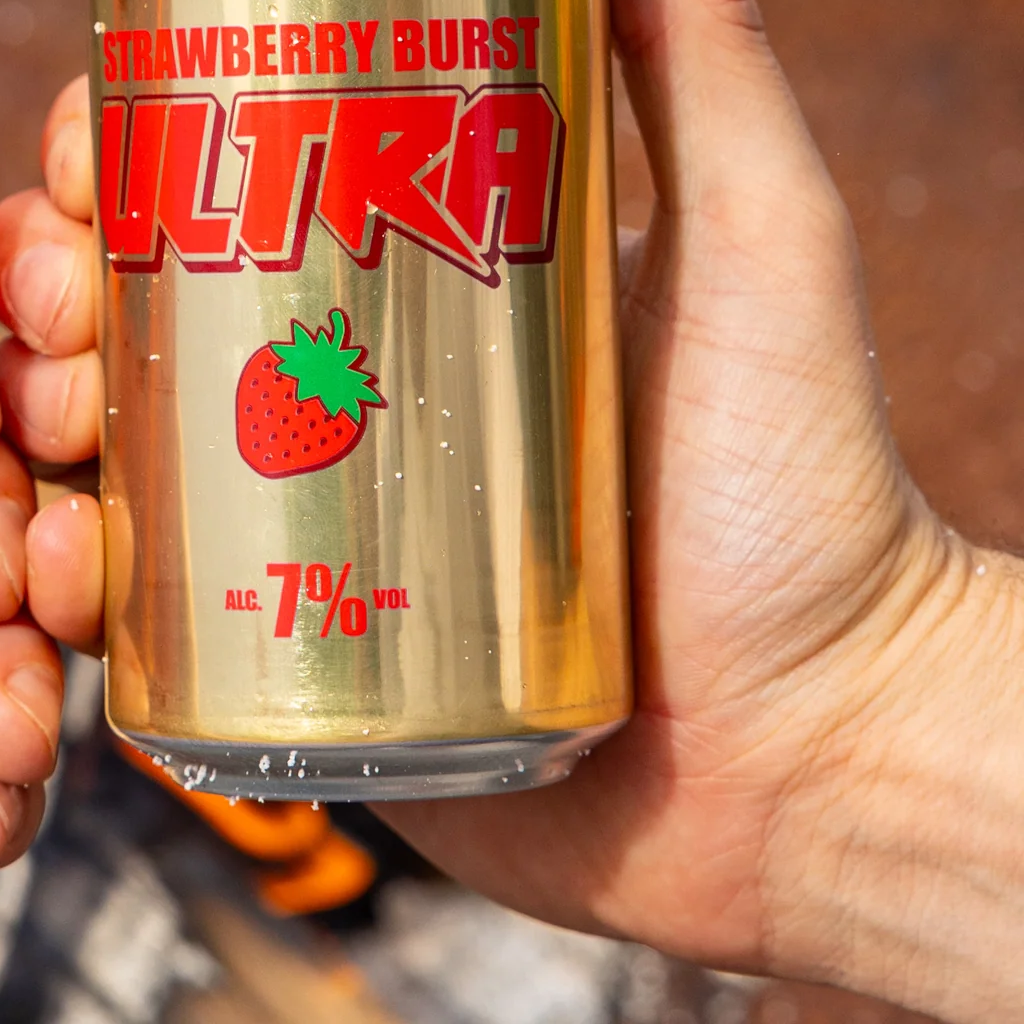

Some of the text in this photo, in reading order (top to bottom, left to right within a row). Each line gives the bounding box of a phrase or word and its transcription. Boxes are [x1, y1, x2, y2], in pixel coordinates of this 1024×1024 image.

[103, 17, 540, 82] STRAWBERRY BURST
[100, 83, 566, 288] ULTRA
[225, 562, 410, 638] ALC. 7% VOL
